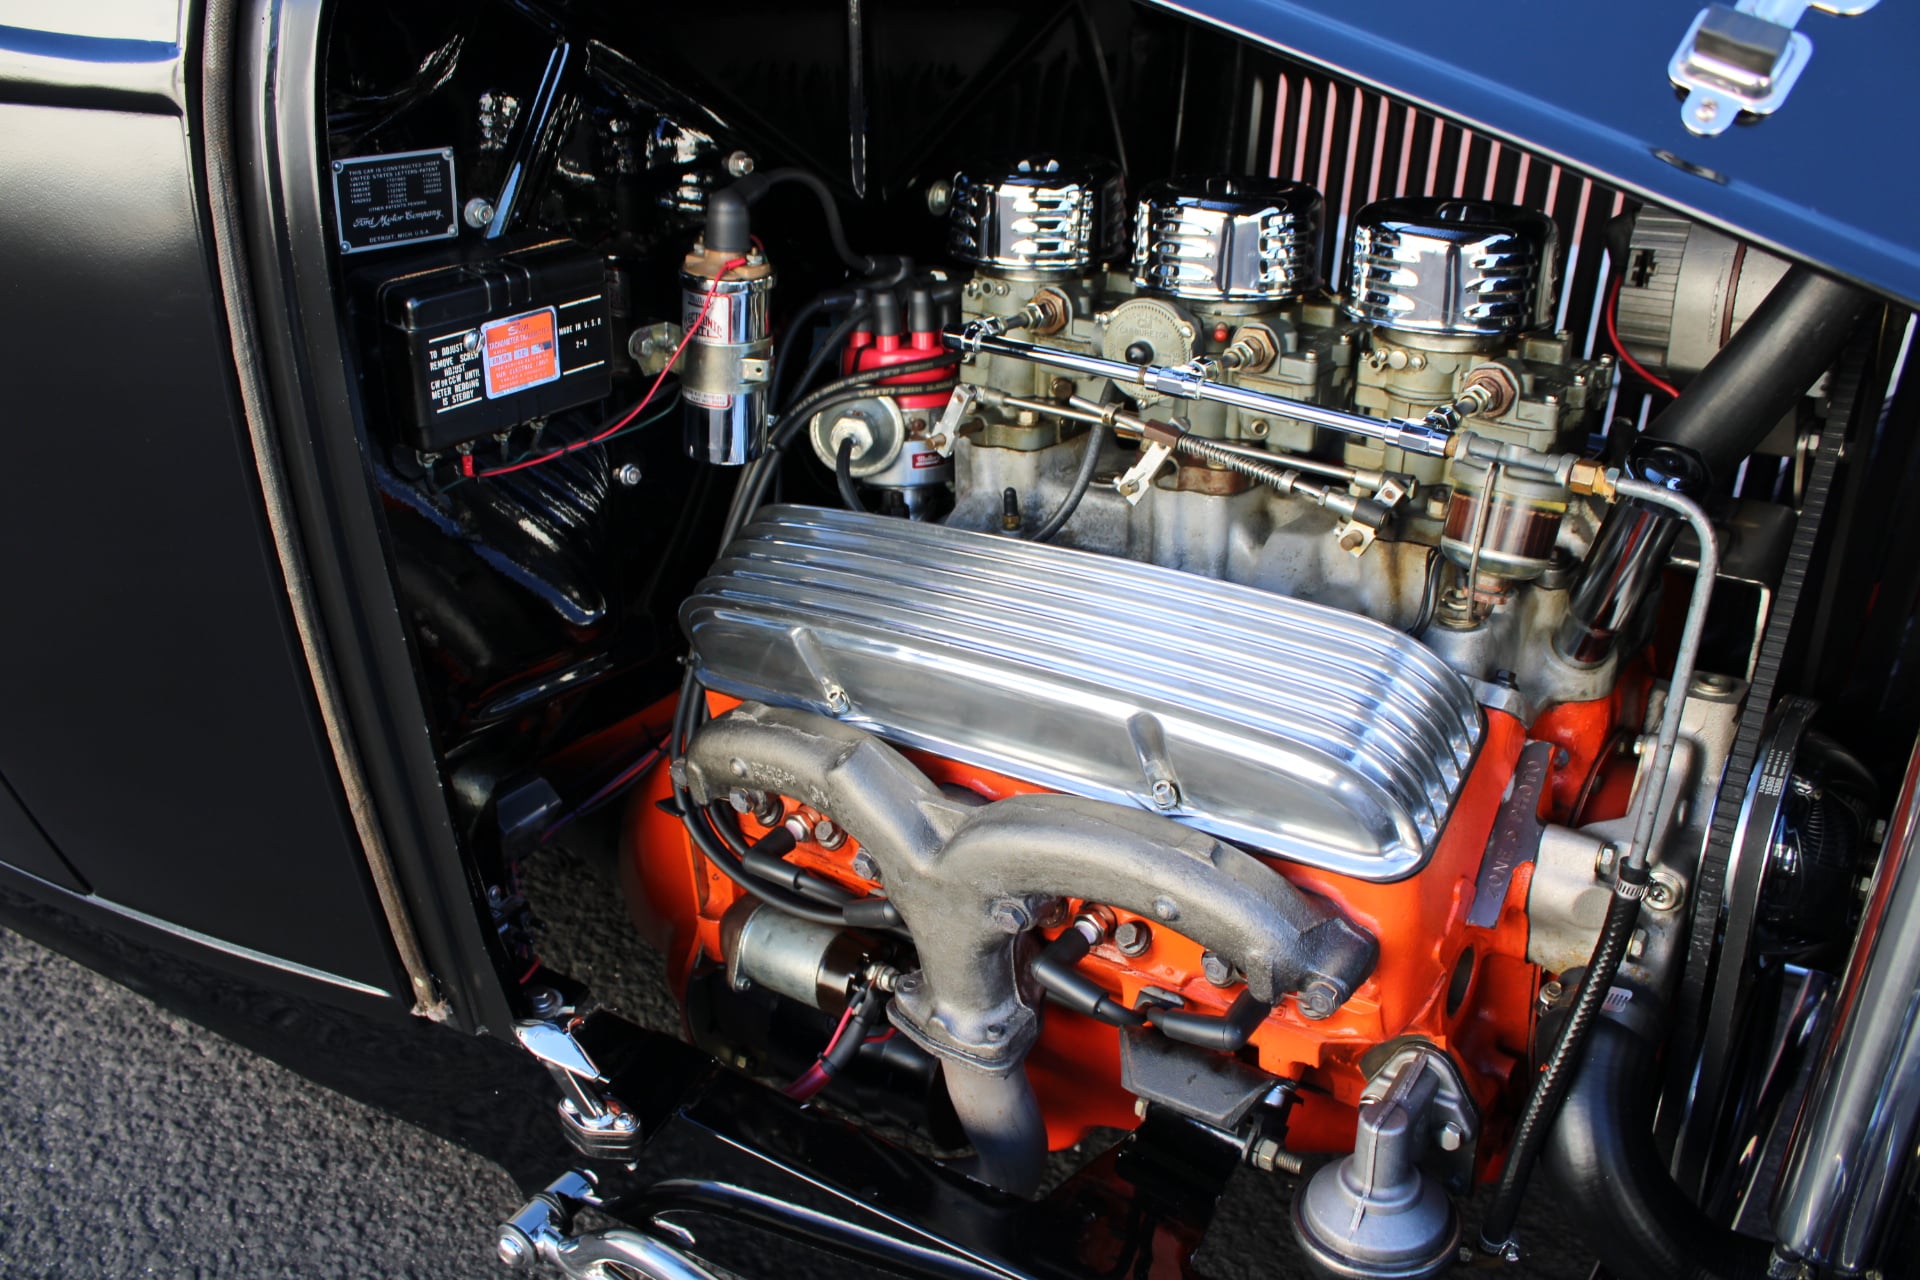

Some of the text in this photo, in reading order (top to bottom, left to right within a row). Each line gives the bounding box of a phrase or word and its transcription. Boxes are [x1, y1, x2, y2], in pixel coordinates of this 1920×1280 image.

[382, 162, 421, 173] CONSTRUCTED
[350, 174, 371, 182] UNITED
[372, 172, 393, 180] STATES
[352, 209, 444, 228] Ford Motor Company
[558, 325, 573, 336] MADE
[575, 323, 581, 332] IN
[1119, 328, 1169, 339] CARBURETOR
[489, 335, 520, 350] TACHOMETER
[429, 343, 463, 360] TO ADJUST
[430, 351, 480, 371] REMOVE SCREW
[444, 363, 466, 377] ADJUST
[430, 379, 441, 390] CW
[448, 374, 461, 385] CCW
[464, 369, 481, 380] UNTIL
[431, 379, 480, 400] METER READING
[442, 389, 474, 406] IS STEADY
[858, 387, 896, 399] ULTRA
[1486, 848, 1515, 901] ZONE
